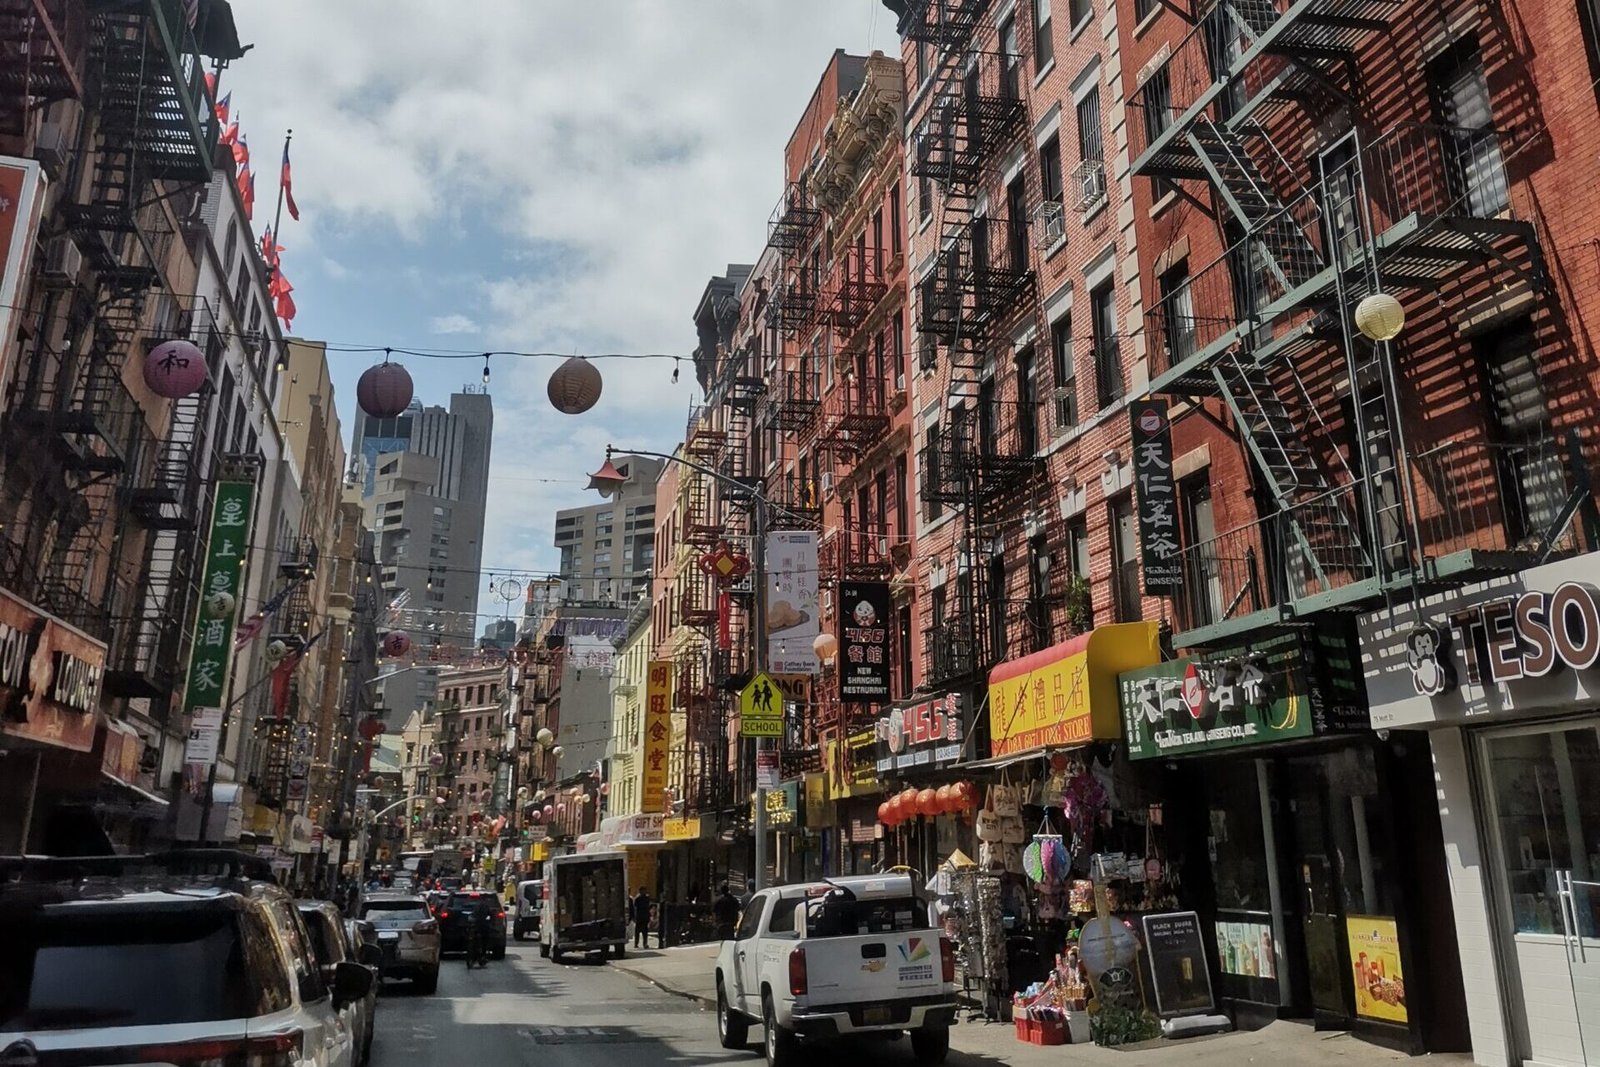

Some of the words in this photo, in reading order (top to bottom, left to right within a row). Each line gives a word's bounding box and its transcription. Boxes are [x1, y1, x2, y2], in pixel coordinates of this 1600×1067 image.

[157, 350, 189, 375] 和
[1139, 442, 1179, 560] 天仁茗茶
[1146, 577, 1183, 585] GINSENG
[845, 628, 885, 644] 456
[1448, 580, 1600, 686] TESO
[843, 686, 887, 695] RESTAURANT
[744, 722, 780, 732] SCHOOL
[902, 698, 943, 746] 456
[1063, 717, 1090, 740] STORE
[635, 817, 650, 829] GIFT
